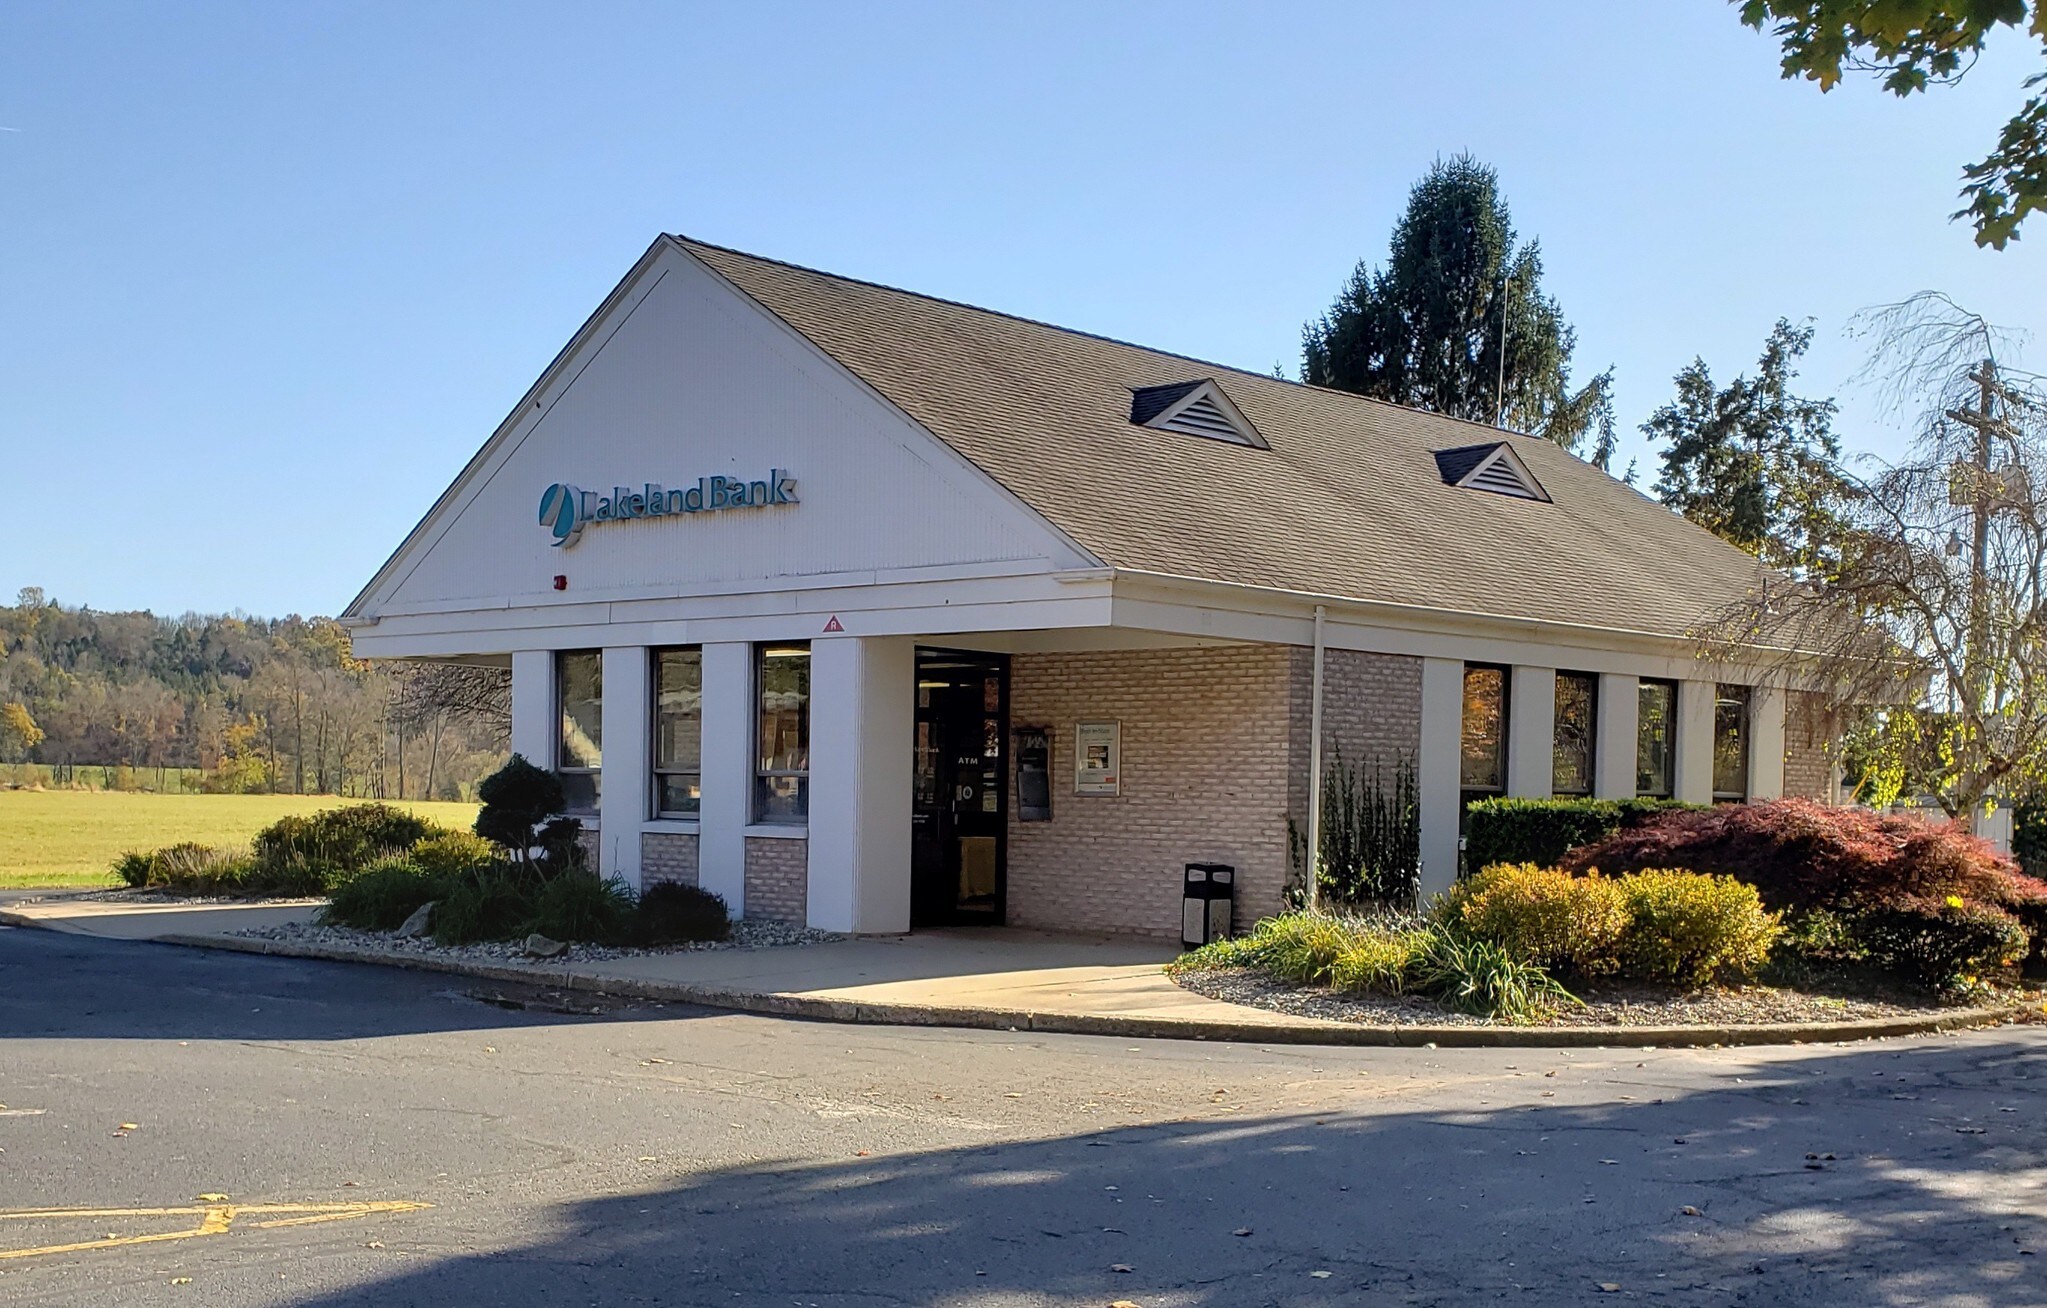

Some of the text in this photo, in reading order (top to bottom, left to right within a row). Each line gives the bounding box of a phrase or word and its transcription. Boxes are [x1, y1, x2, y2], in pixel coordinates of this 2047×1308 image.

[580, 469, 795, 521] Lakeland Bank
[830, 620, 837, 631] R
[958, 757, 978, 765] ATM
